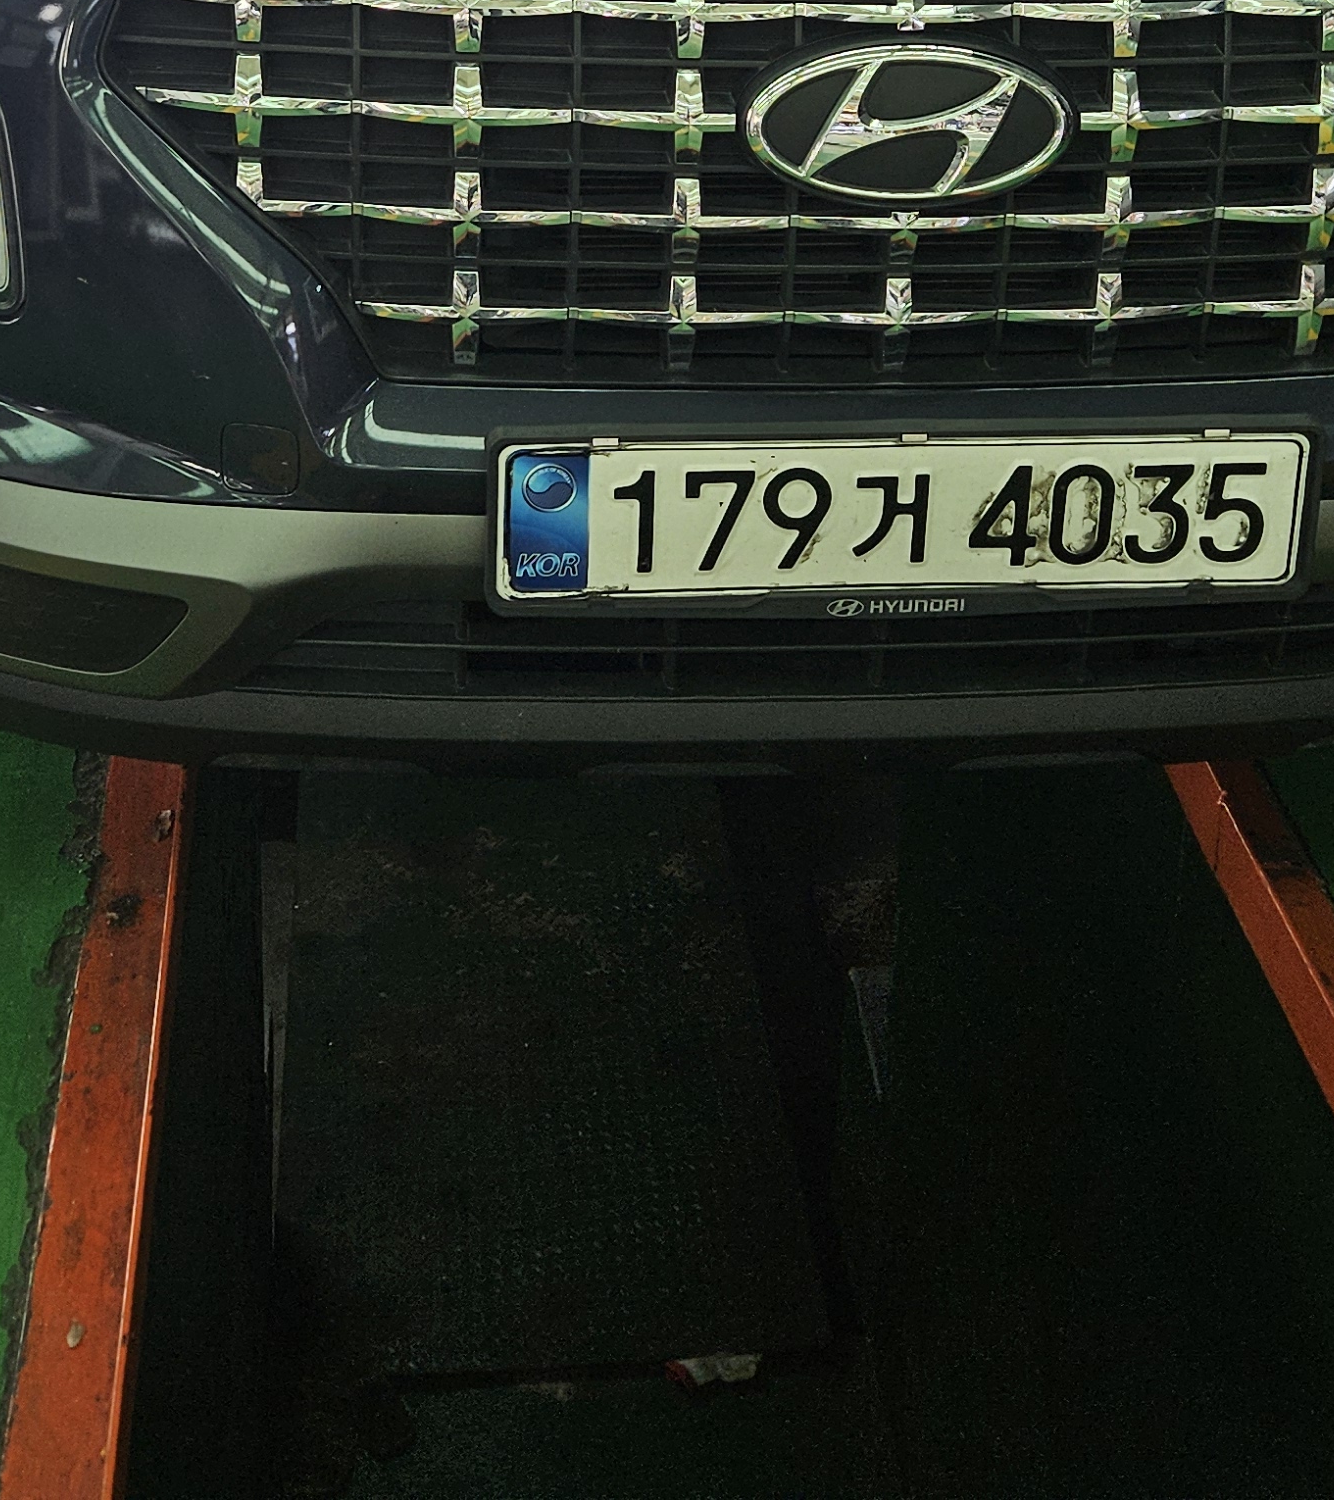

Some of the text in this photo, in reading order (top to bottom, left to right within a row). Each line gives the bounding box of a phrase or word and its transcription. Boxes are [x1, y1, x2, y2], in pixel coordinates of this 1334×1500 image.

[613, 462, 1268, 574] 179거 4035
[515, 553, 580, 577] KOR
[870, 598, 965, 614] HYUNDAI
